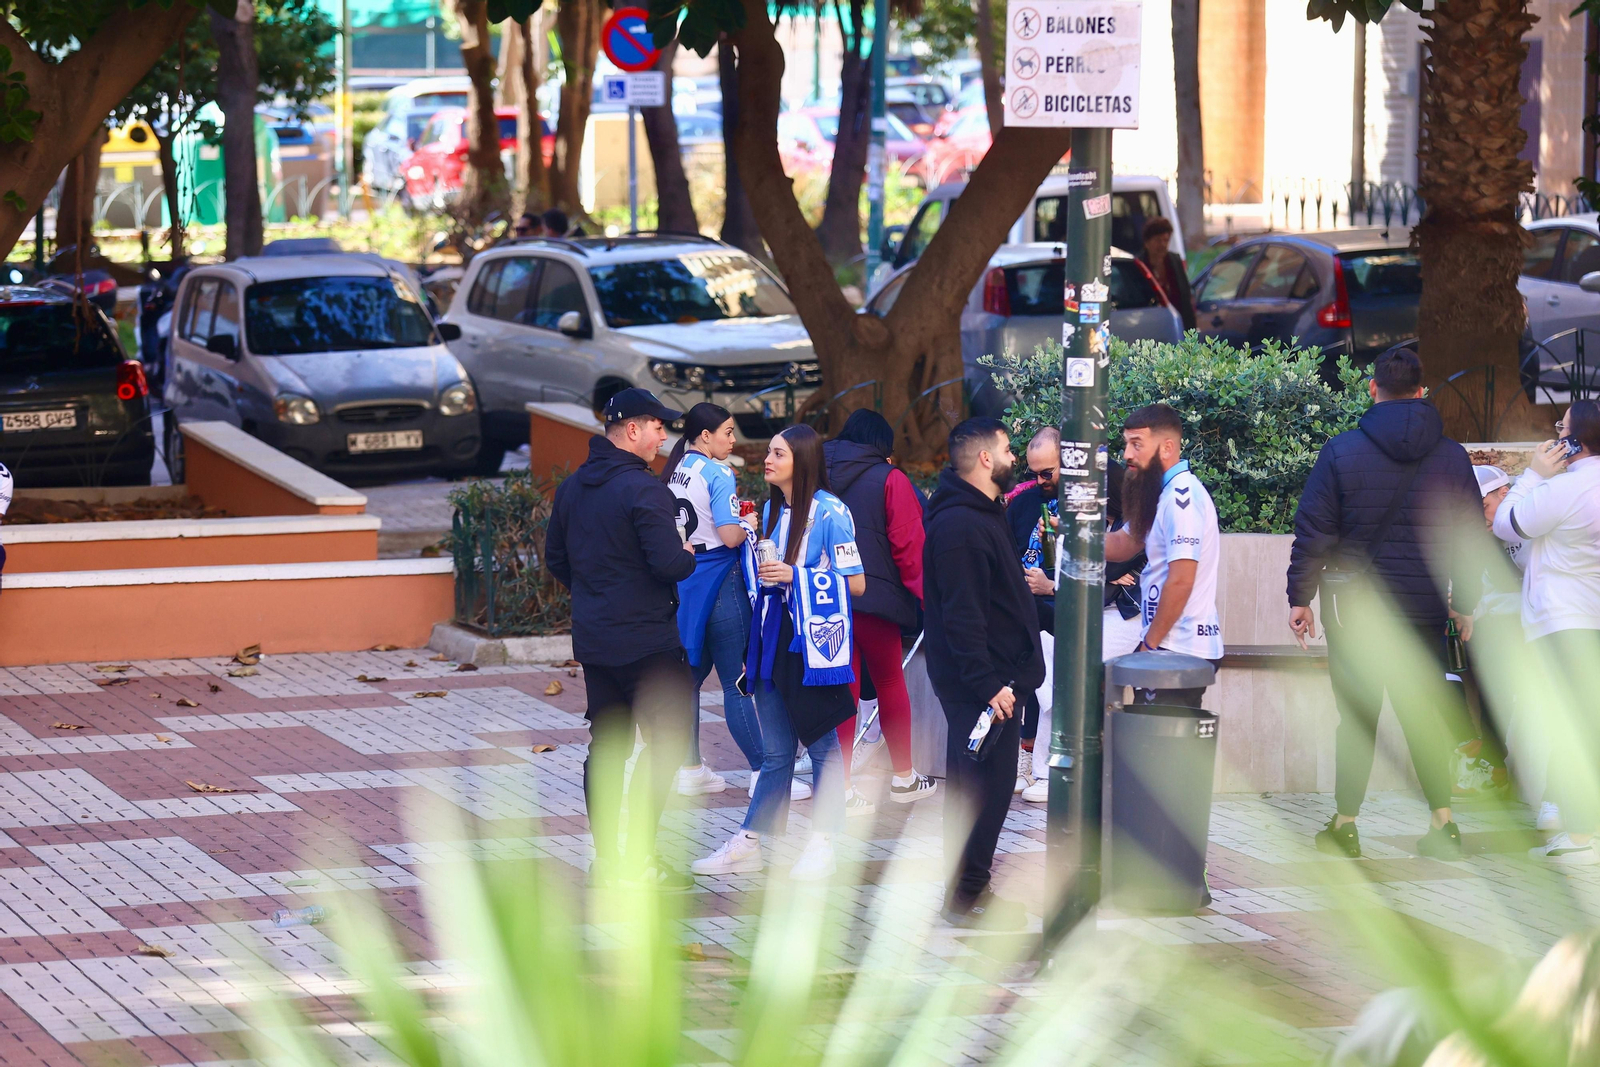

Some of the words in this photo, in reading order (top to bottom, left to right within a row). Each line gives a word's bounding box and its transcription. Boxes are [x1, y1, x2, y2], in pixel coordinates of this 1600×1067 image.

[1046, 16, 1117, 34] BALONES
[1045, 56, 1107, 74] PERR
[1044, 95, 1132, 113] BICICLETAS
[1170, 535, 1200, 547] málaga
